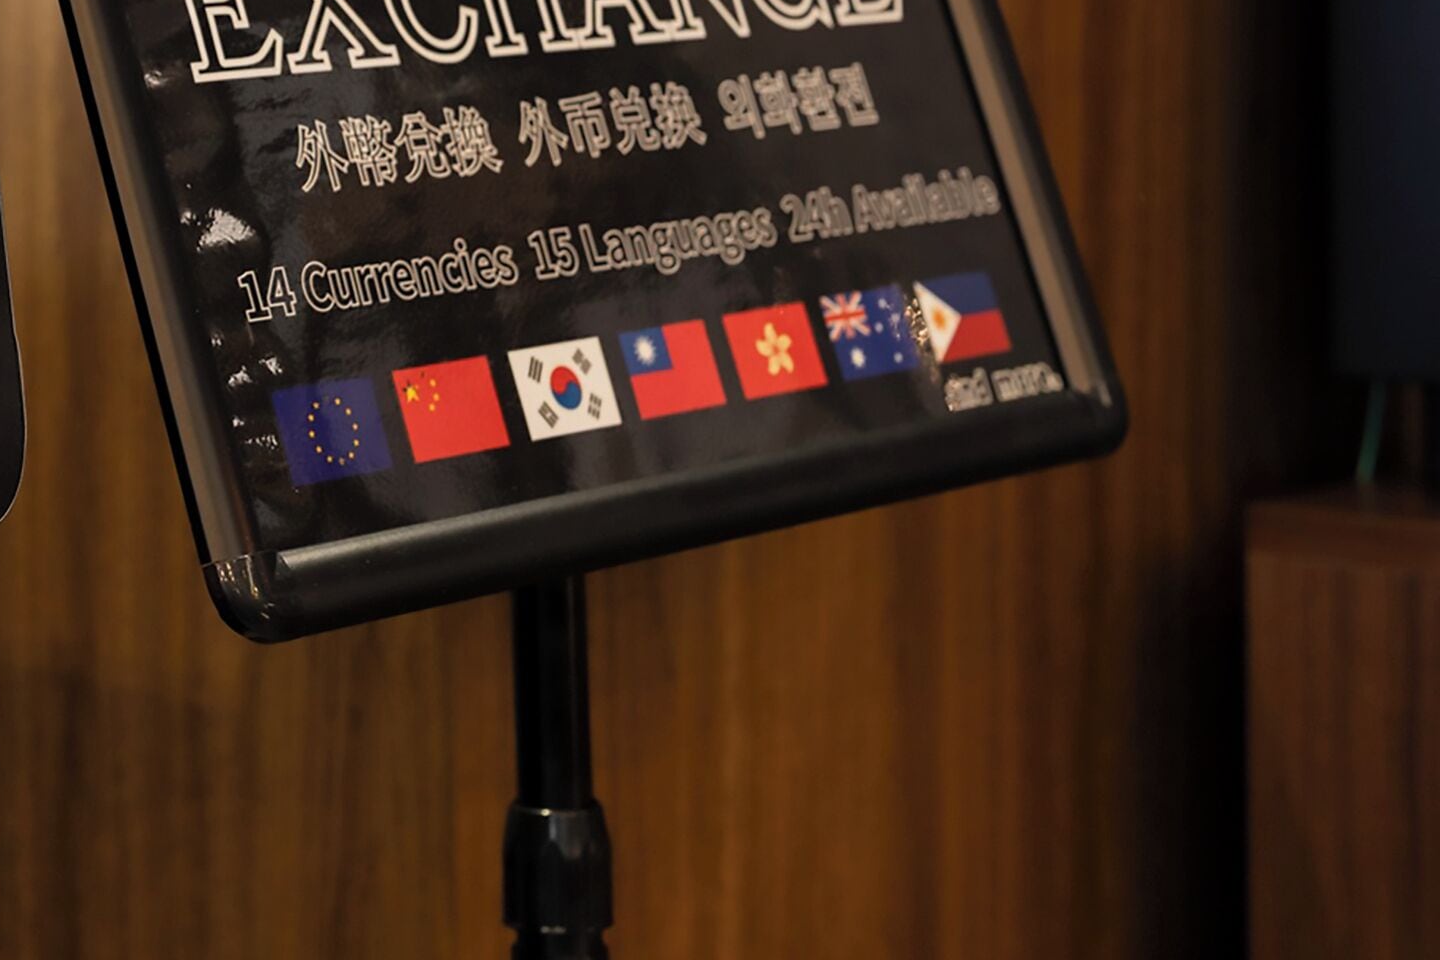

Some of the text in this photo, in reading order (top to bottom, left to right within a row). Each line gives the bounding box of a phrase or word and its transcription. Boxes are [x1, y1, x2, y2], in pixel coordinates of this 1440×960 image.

[295, 61, 881, 193] 外幣兌換 外币兑换 외화환전
[237, 165, 1002, 323] 14 Currencies 15 Languages 24h Available
